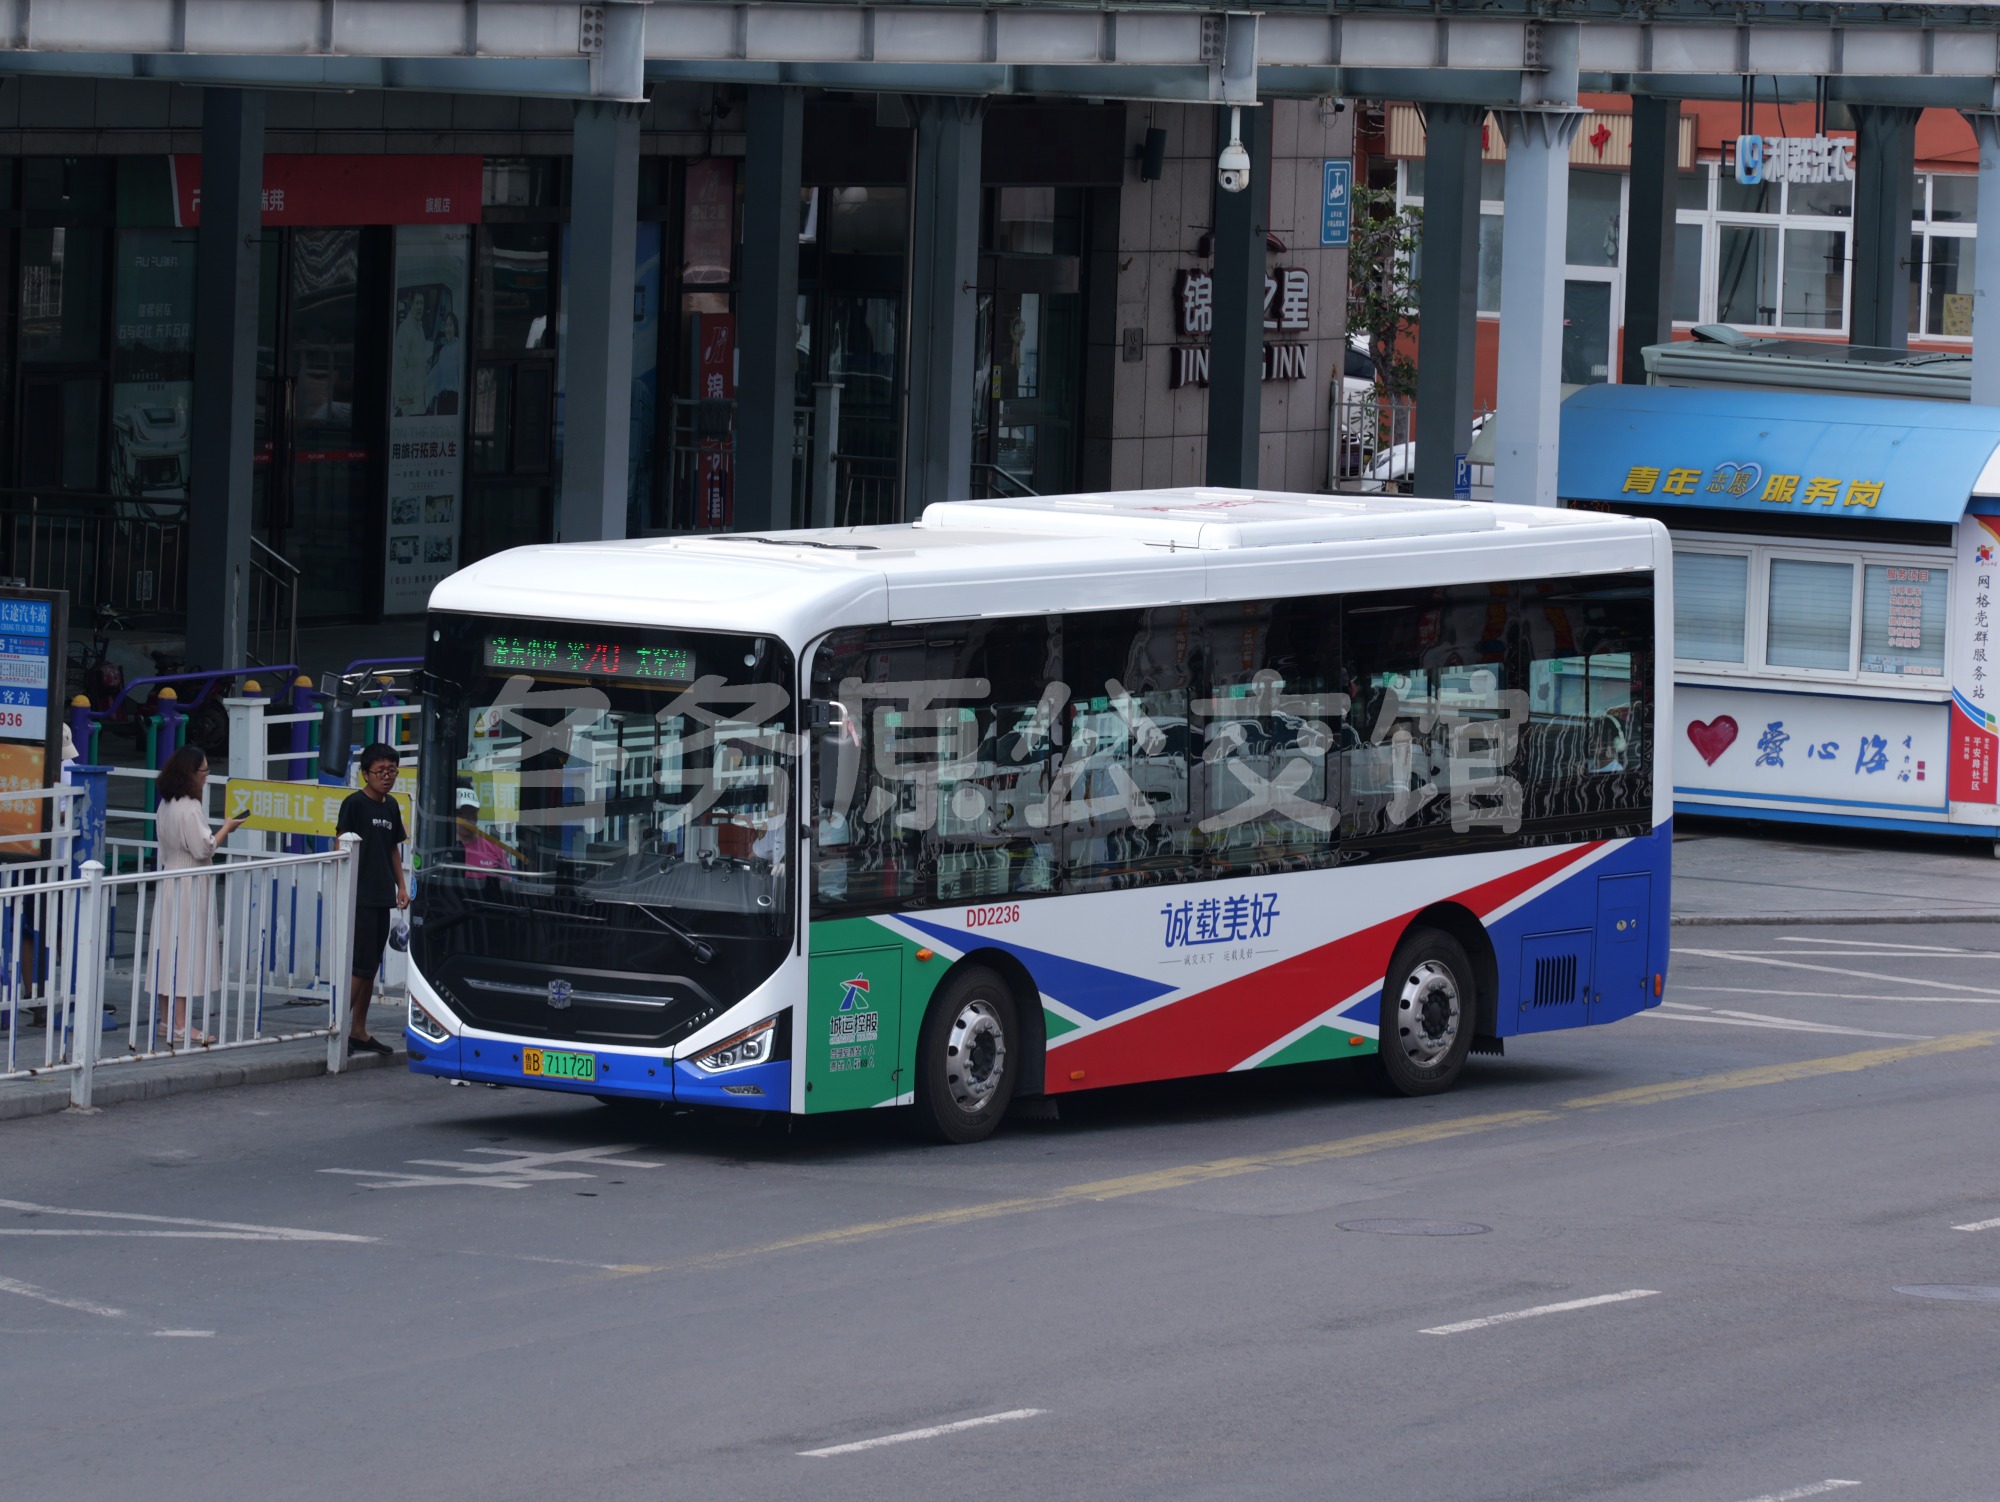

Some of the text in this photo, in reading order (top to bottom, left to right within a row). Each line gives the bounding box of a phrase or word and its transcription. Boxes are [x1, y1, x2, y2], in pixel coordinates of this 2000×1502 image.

[1763, 134, 1854, 184] 利群洗衣
[425, 197, 451, 214] 旗舰店
[1183, 271, 1309, 332] 锦之星
[1272, 345, 1308, 380] INN
[392, 440, 457, 460] 用旅行拓宽人生
[1760, 474, 1885, 509] 服务岗
[1886, 568, 1929, 582] 服务项目
[1, 602, 48, 624] 长途汽车站
[1971, 574, 1991, 700] 网格党群服务站
[2, 690, 31, 706] 客站
[1971, 736, 1982, 791] 平安路社区
[231, 788, 313, 823] 文明礼让
[966, 903, 1020, 929] DD2236
[1160, 892, 1281, 948] 诚载美好
[1223, 947, 1253, 962] 运载美好
[830, 1013, 877, 1035] 城运控股
